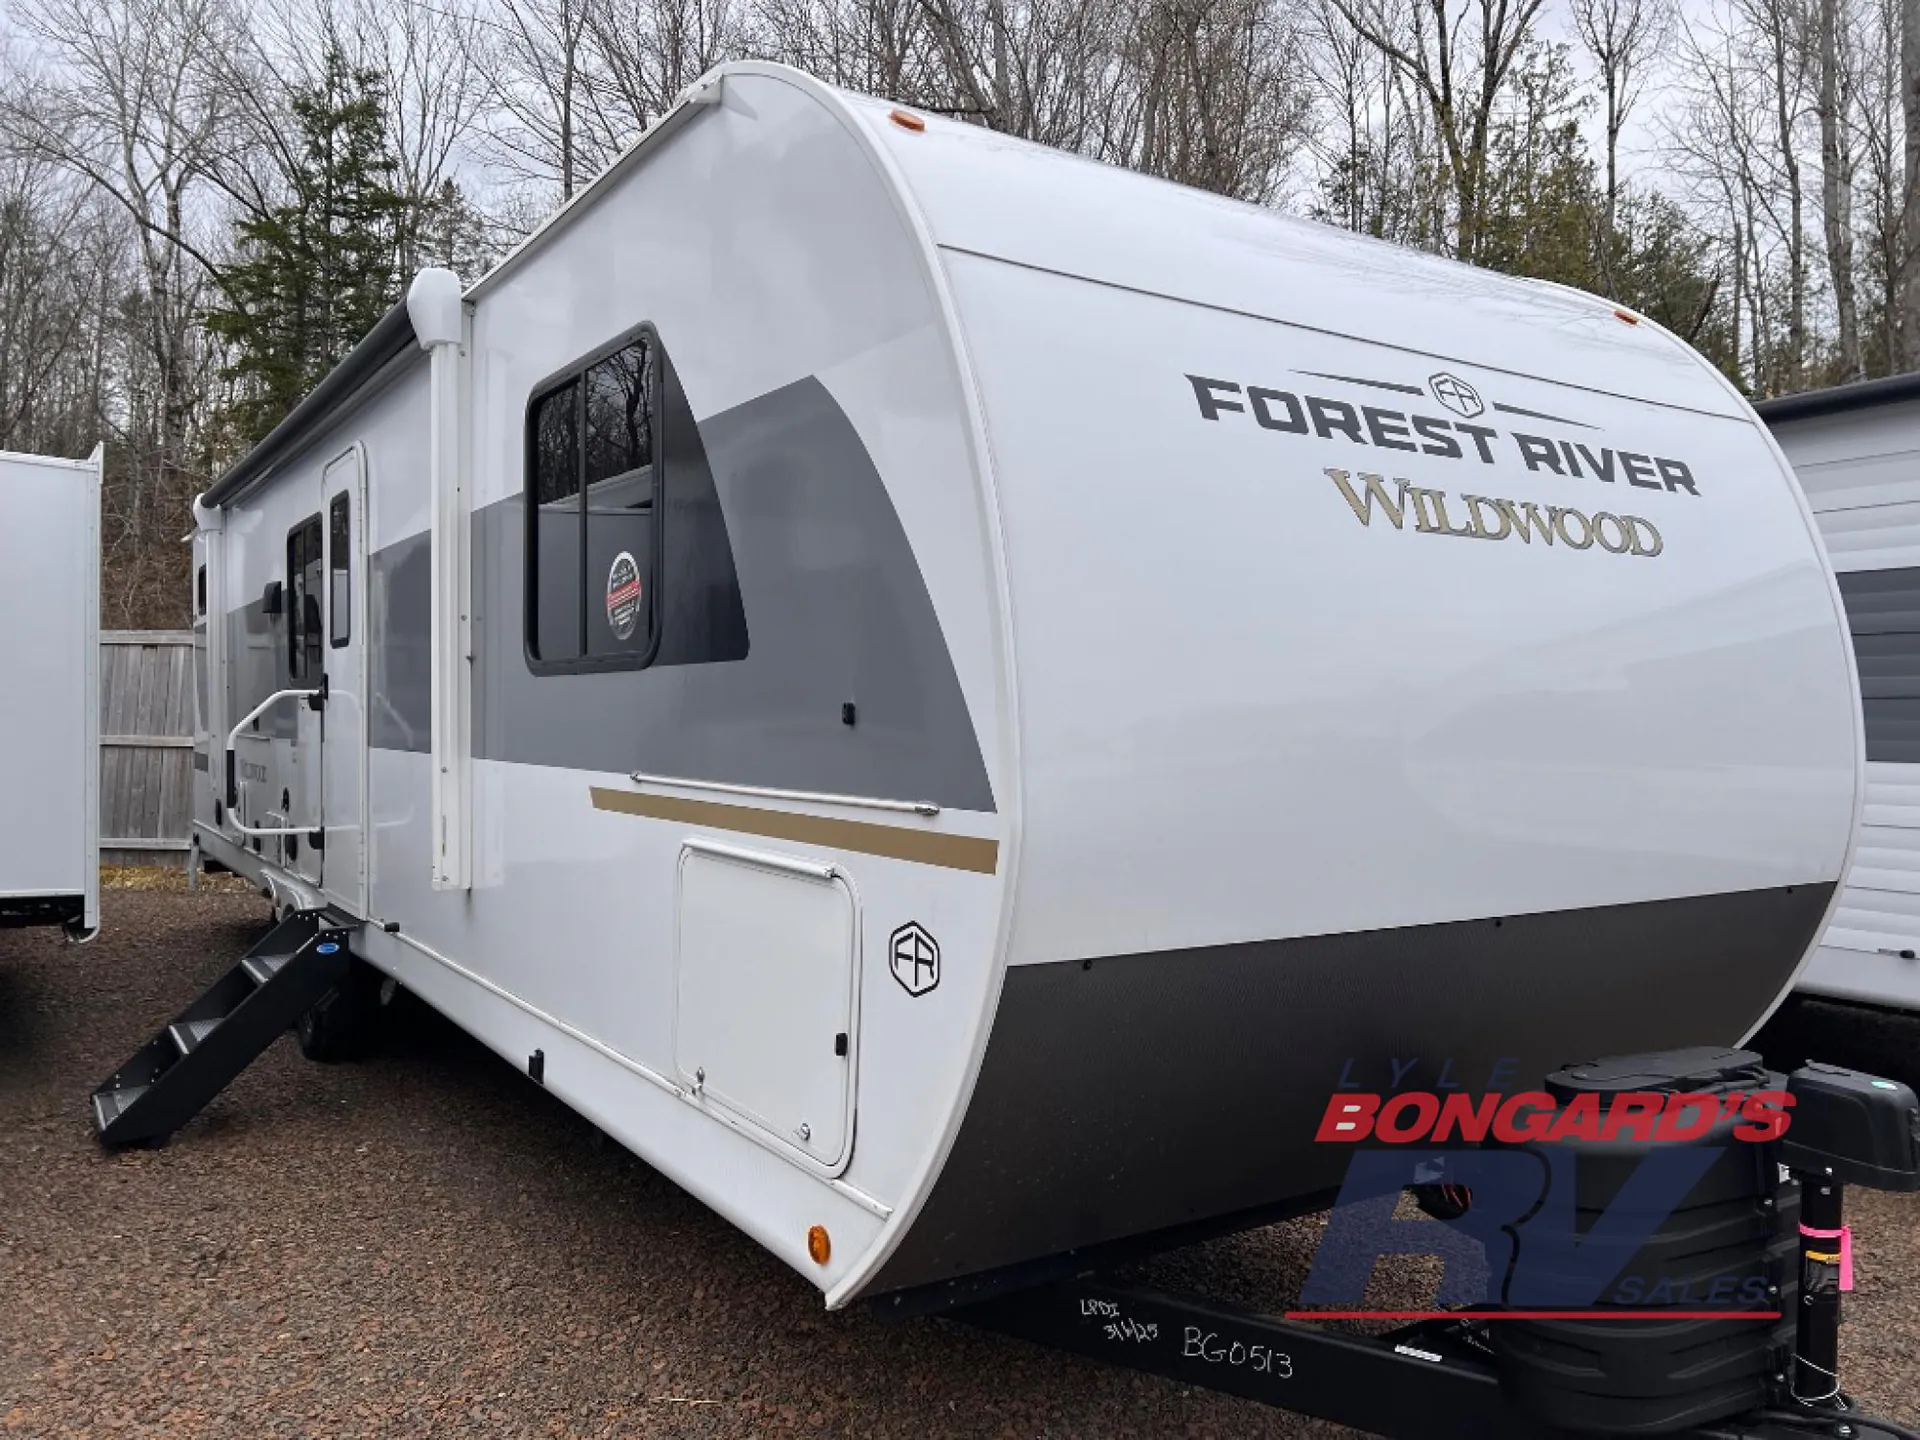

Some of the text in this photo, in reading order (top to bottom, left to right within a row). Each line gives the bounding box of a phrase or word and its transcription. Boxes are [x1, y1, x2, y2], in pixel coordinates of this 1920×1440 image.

[1184, 373, 1702, 497] FOREST RIVER
[1323, 467, 1664, 558] WILDWOOD
